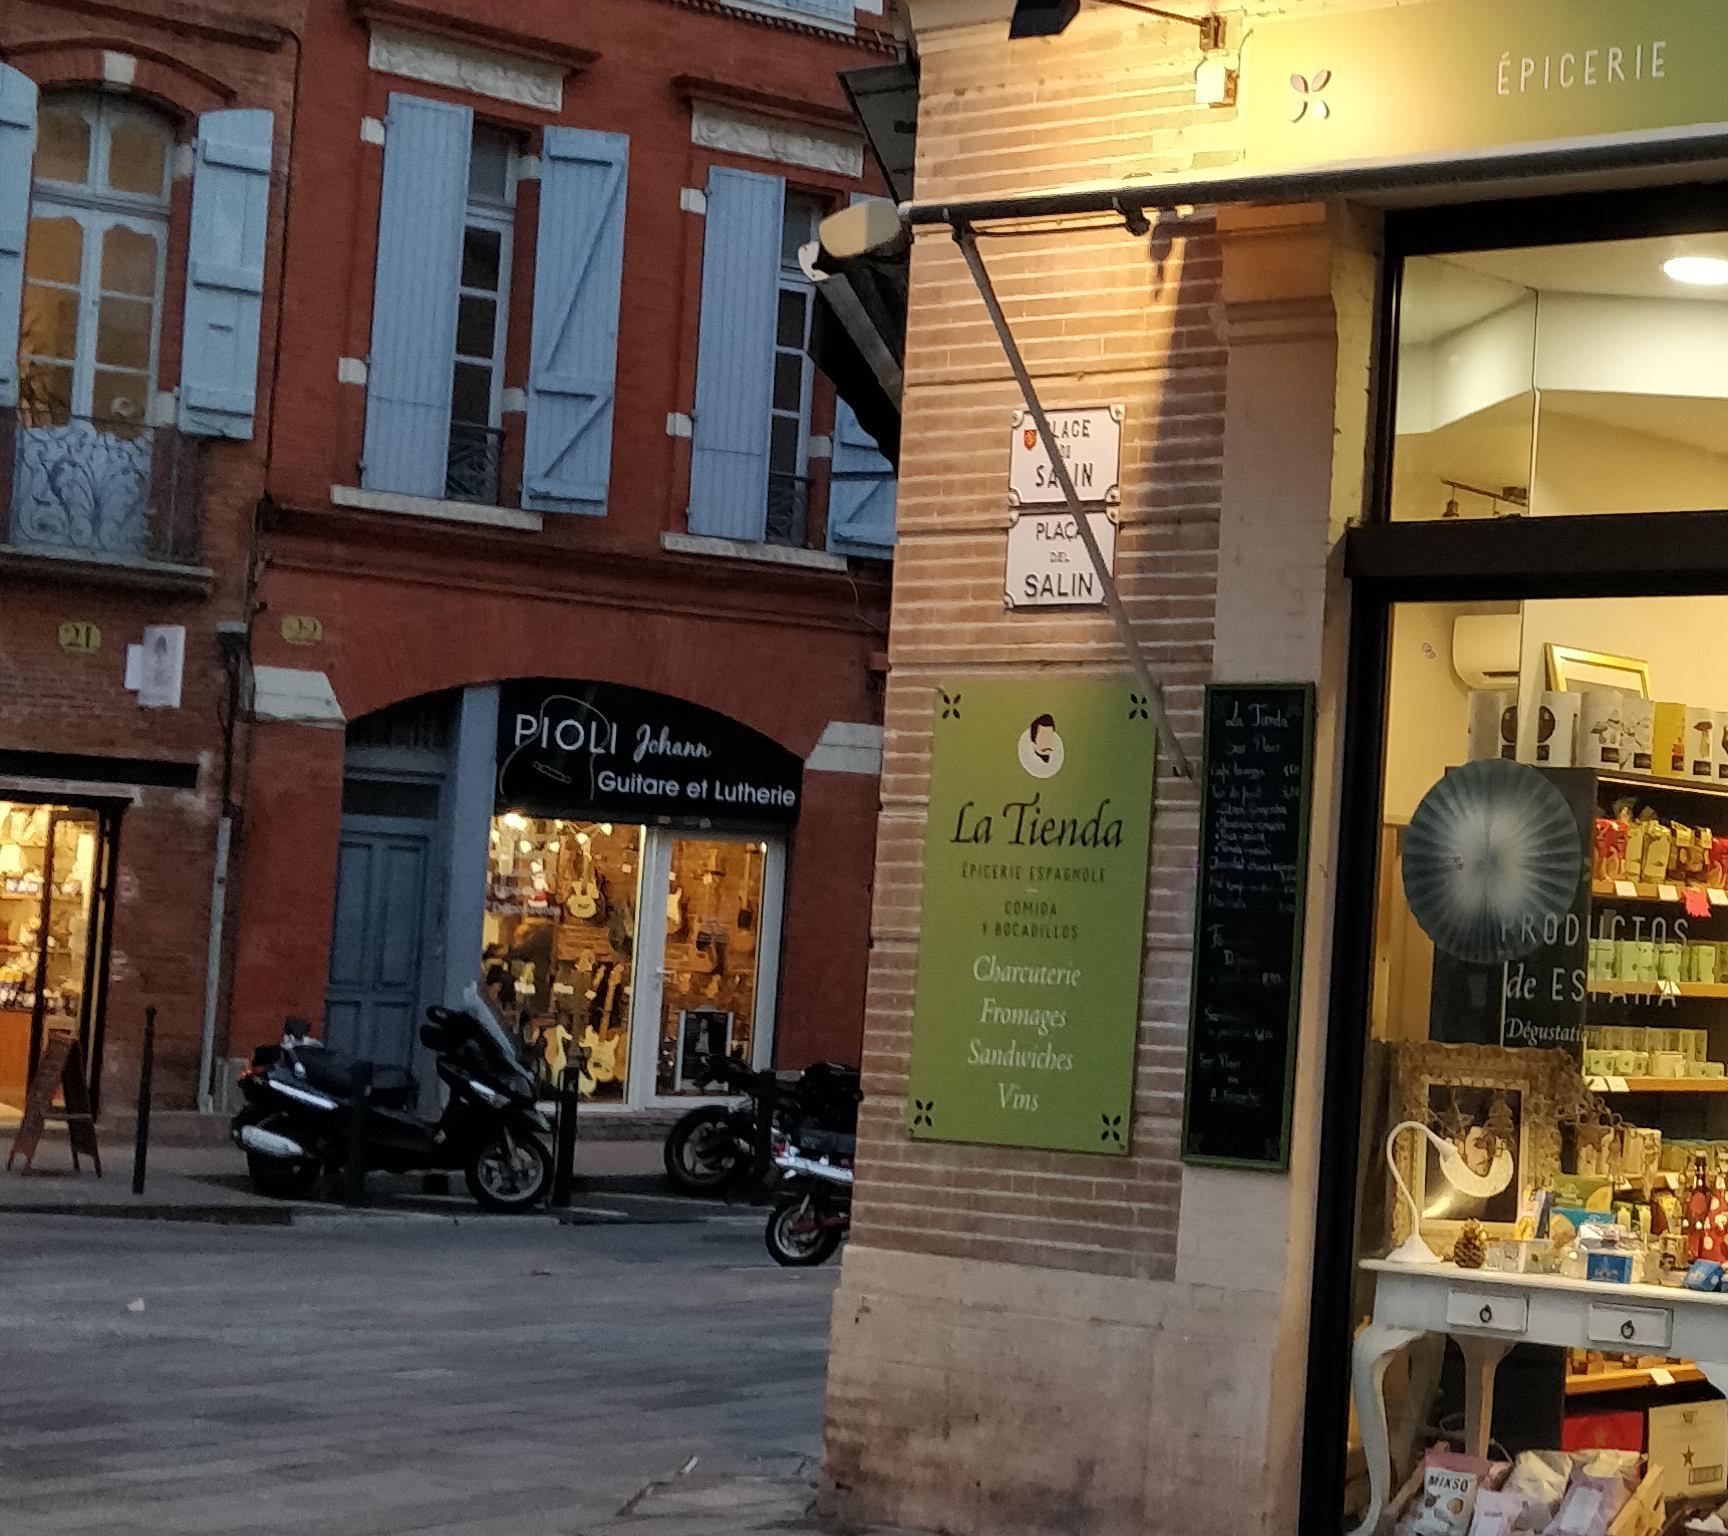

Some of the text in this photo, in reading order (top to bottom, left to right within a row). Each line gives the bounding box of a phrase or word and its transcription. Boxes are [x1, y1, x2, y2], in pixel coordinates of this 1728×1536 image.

[1496, 40, 1668, 96] ÉPICERIE
[1034, 463, 1094, 489] SAIN
[1050, 551, 1071, 564] DEL
[1024, 572, 1094, 600] SALIN
[514, 714, 712, 763] PIOLI Johann
[598, 770, 797, 808] Guitare et Lutherie
[949, 792, 1124, 848] La Tienda
[1029, 865, 1107, 883] ESPAGNOLE
[1004, 900, 1057, 915] COMIDA
[994, 921, 1079, 940] BOCADILLOS
[973, 954, 1083, 986] Charcuterie
[1506, 962, 1538, 1000] de
[979, 997, 1068, 1037] Fromages
[967, 1039, 1075, 1071] Sandwiches
[998, 1082, 1041, 1112] Vins
